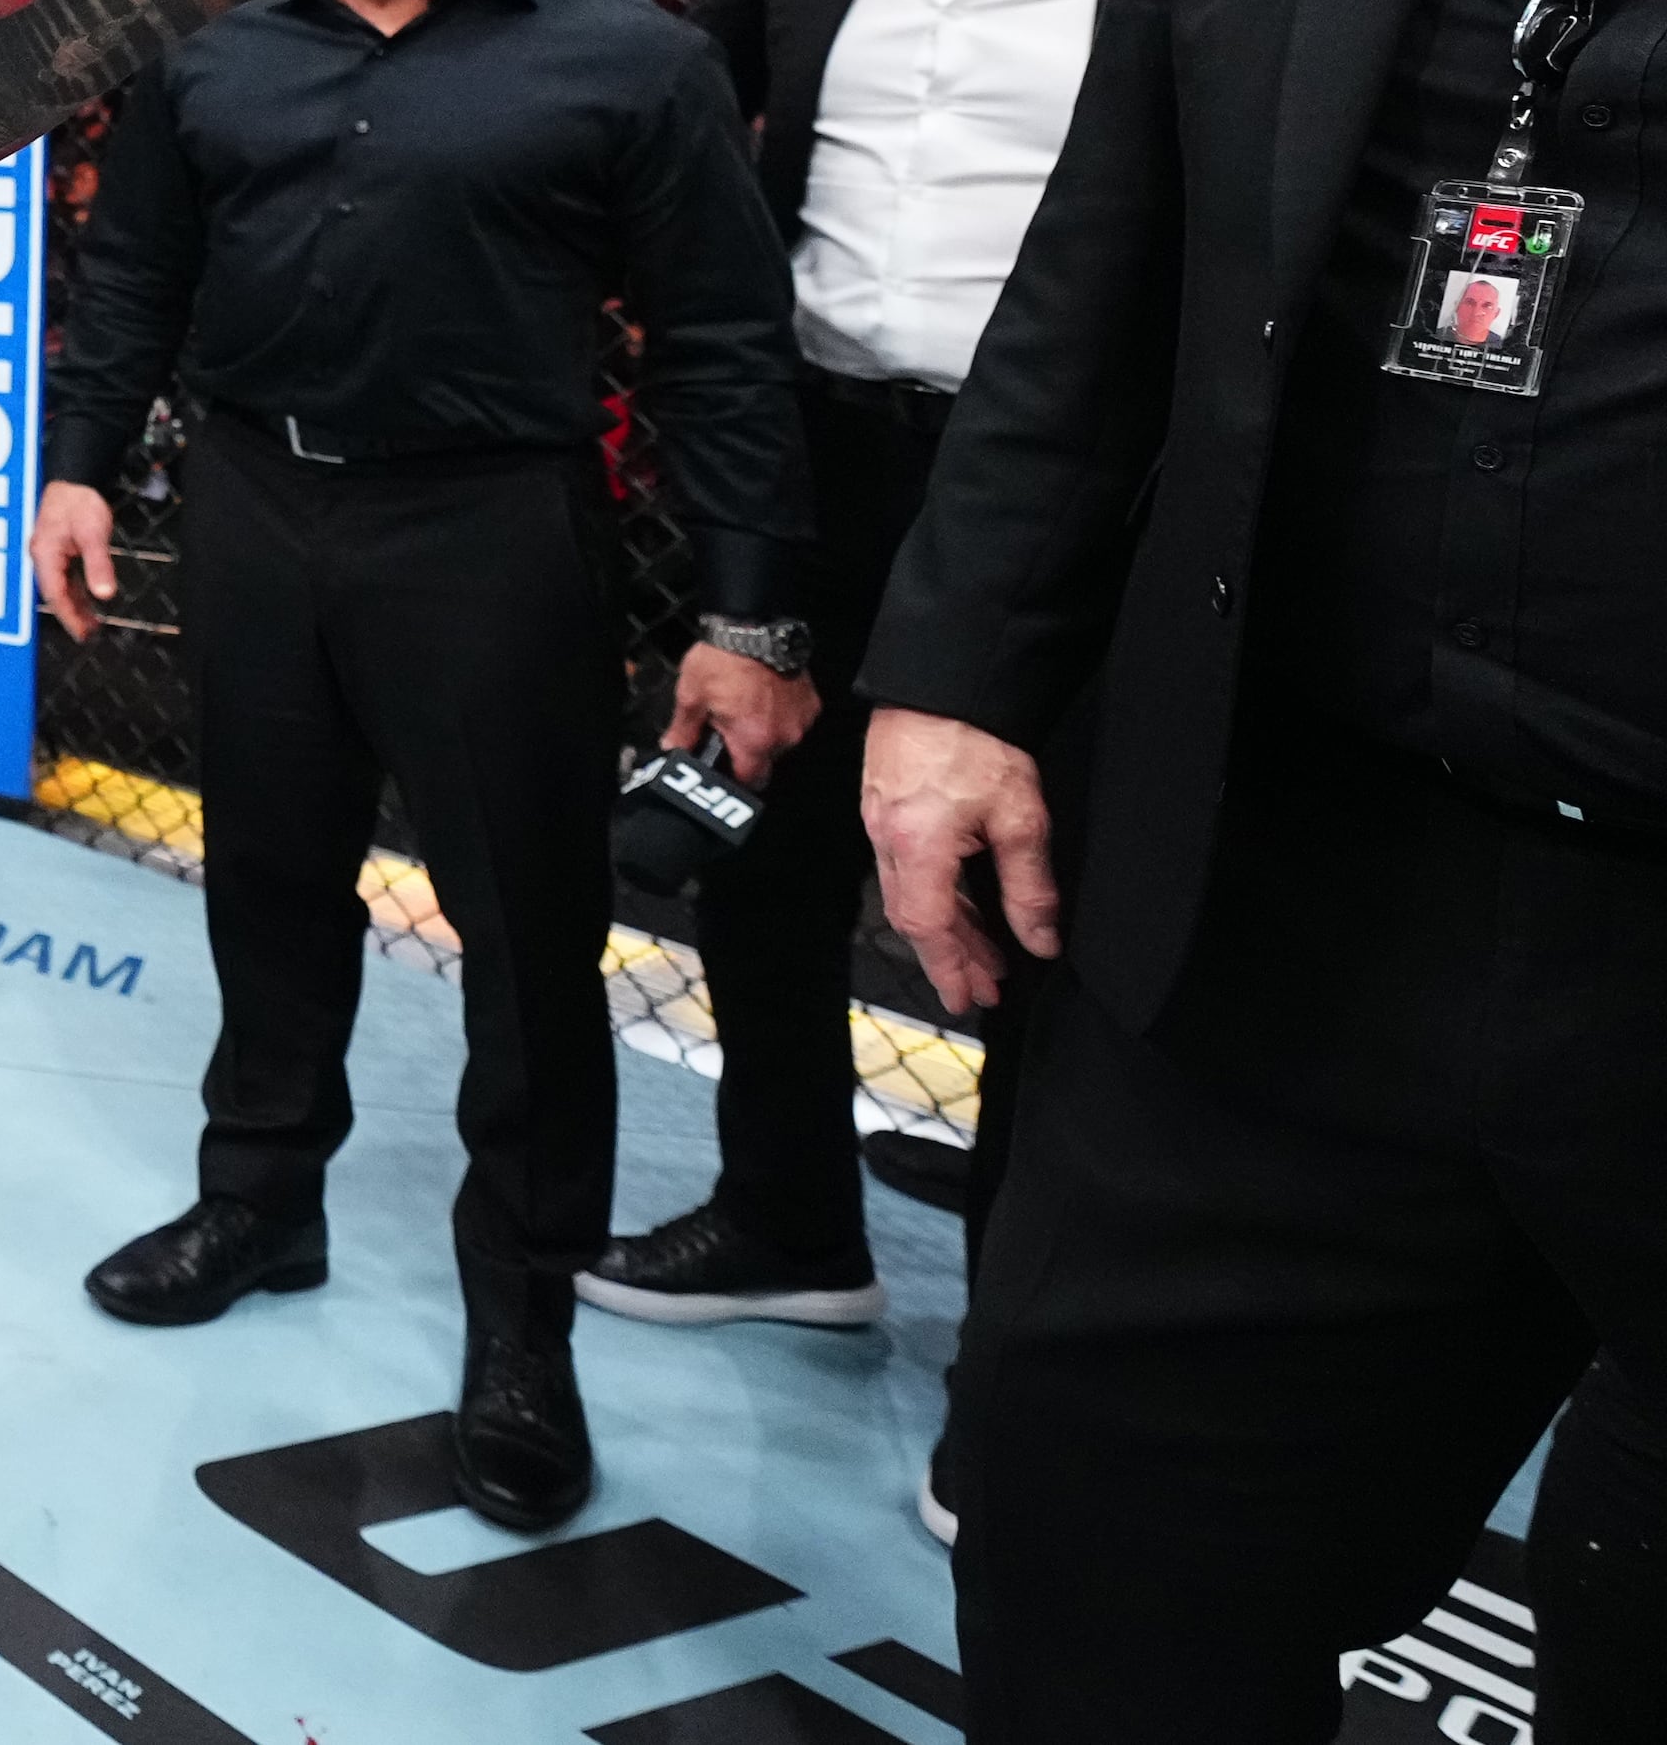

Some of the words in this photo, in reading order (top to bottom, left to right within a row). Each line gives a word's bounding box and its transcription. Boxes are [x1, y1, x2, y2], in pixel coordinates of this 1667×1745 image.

[1471, 232, 1514, 250] UFC
[661, 762, 755, 829] UFC
[47, 1649, 142, 1721] PEREZ
[73, 1647, 143, 1700] IVAN
